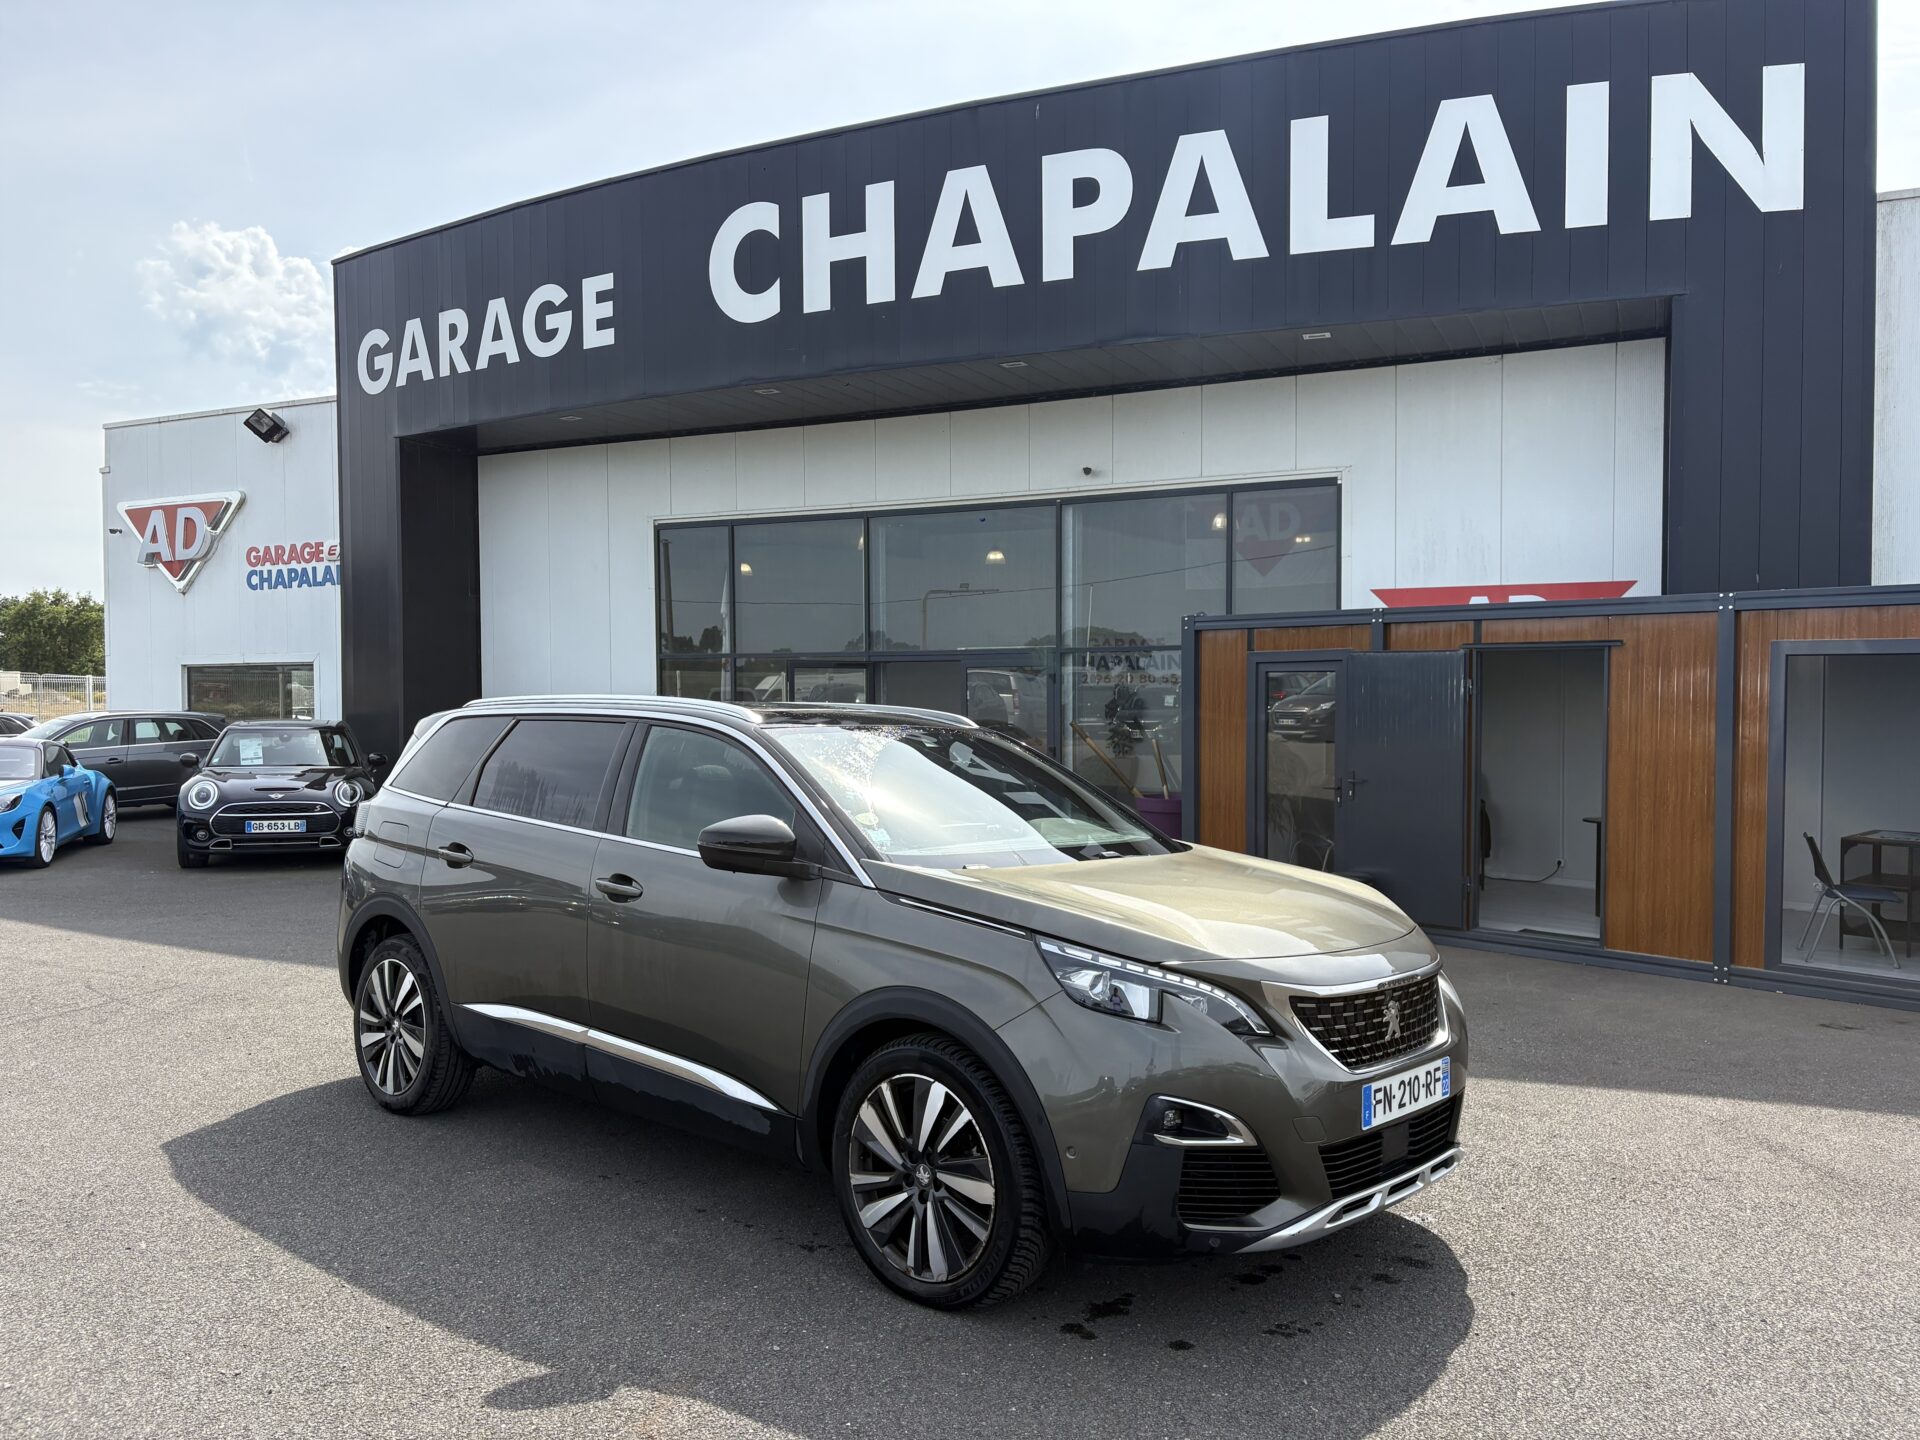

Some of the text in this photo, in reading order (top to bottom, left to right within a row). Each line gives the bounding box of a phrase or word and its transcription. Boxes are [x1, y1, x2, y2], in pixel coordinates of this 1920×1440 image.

[358, 63, 1806, 395] GARAGE CHAPALAIN
[137, 507, 208, 562] AD
[245, 542, 325, 568] GARAGE
[252, 822, 300, 831] GB-653-LB
[1373, 1066, 1441, 1119] FN-210-RF
